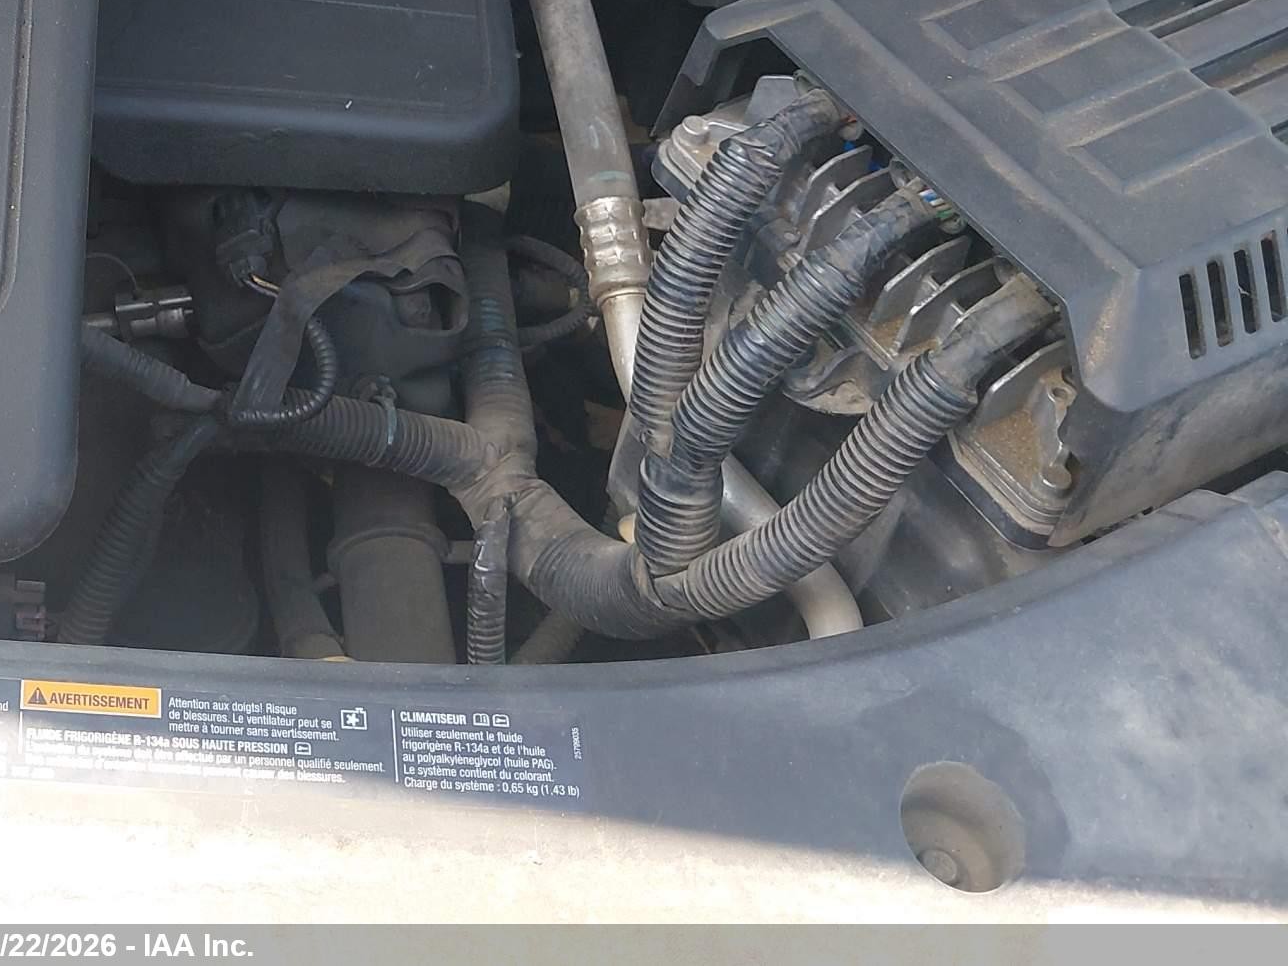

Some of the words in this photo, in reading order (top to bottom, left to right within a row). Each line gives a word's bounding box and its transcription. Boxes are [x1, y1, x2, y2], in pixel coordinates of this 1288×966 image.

[49, 692, 150, 710] AVERTISSEMENT
[168, 698, 210, 711] Attention
[212, 701, 229, 711] aux
[232, 702, 263, 715] doigts!
[266, 704, 297, 716] Risque
[168, 710, 181, 720] de
[183, 710, 230, 722] blessures.
[233, 713, 244, 724] Le
[246, 714, 294, 727] ventilateur
[298, 718, 318, 731] peut
[321, 720, 333, 729] se
[400, 712, 467, 725] CLIMATISEUR
[26, 727, 63, 741] FLUIDE
[64, 729, 132, 746] FRIGORIGÈNE
[133, 734, 170, 748] R-134a
[171, 736, 200, 749] SOUS
[202, 738, 236, 752] HAUTE
[238, 740, 288, 755] PRESSION
[168, 722, 200, 733] mettre
[202, 723, 208, 733] à
[210, 724, 244, 736] tourner
[246, 727, 269, 737] sans
[271, 727, 340, 742] avertissement.
[401, 727, 433, 738] Utiliser
[435, 728, 484, 740] seulement
[486, 731, 495, 741] le
[497, 731, 523, 743] fluide
[401, 738, 452, 753] frigorigène
[454, 741, 489, 754] R-134a
[491, 744, 501, 754] et
[503, 744, 515, 755] de
[517, 745, 546, 757] l'huile
[216, 754, 232, 766] par
[234, 755, 247, 765] un
[249, 756, 295, 770] personnel
[298, 758, 332, 771] qualifié
[334, 760, 386, 773] seulement.
[402, 753, 414, 763] au
[417, 752, 501, 769] polyalkylèneglycol
[503, 756, 530, 770] (huile
[532, 759, 557, 771] PAG).
[297, 770, 346, 784] blessures.
[403, 764, 415, 775] Le
[417, 765, 457, 779] système
[459, 767, 497, 779] contient
[499, 769, 512, 780] du
[514, 770, 554, 782] colorant.
[404, 776, 438, 791] Charge
[440, 778, 452, 789] du
[455, 779, 495, 793] système
[502, 783, 524, 795] 0,65
[526, 784, 539, 797] kg
[568, 785, 580, 799] lb)
